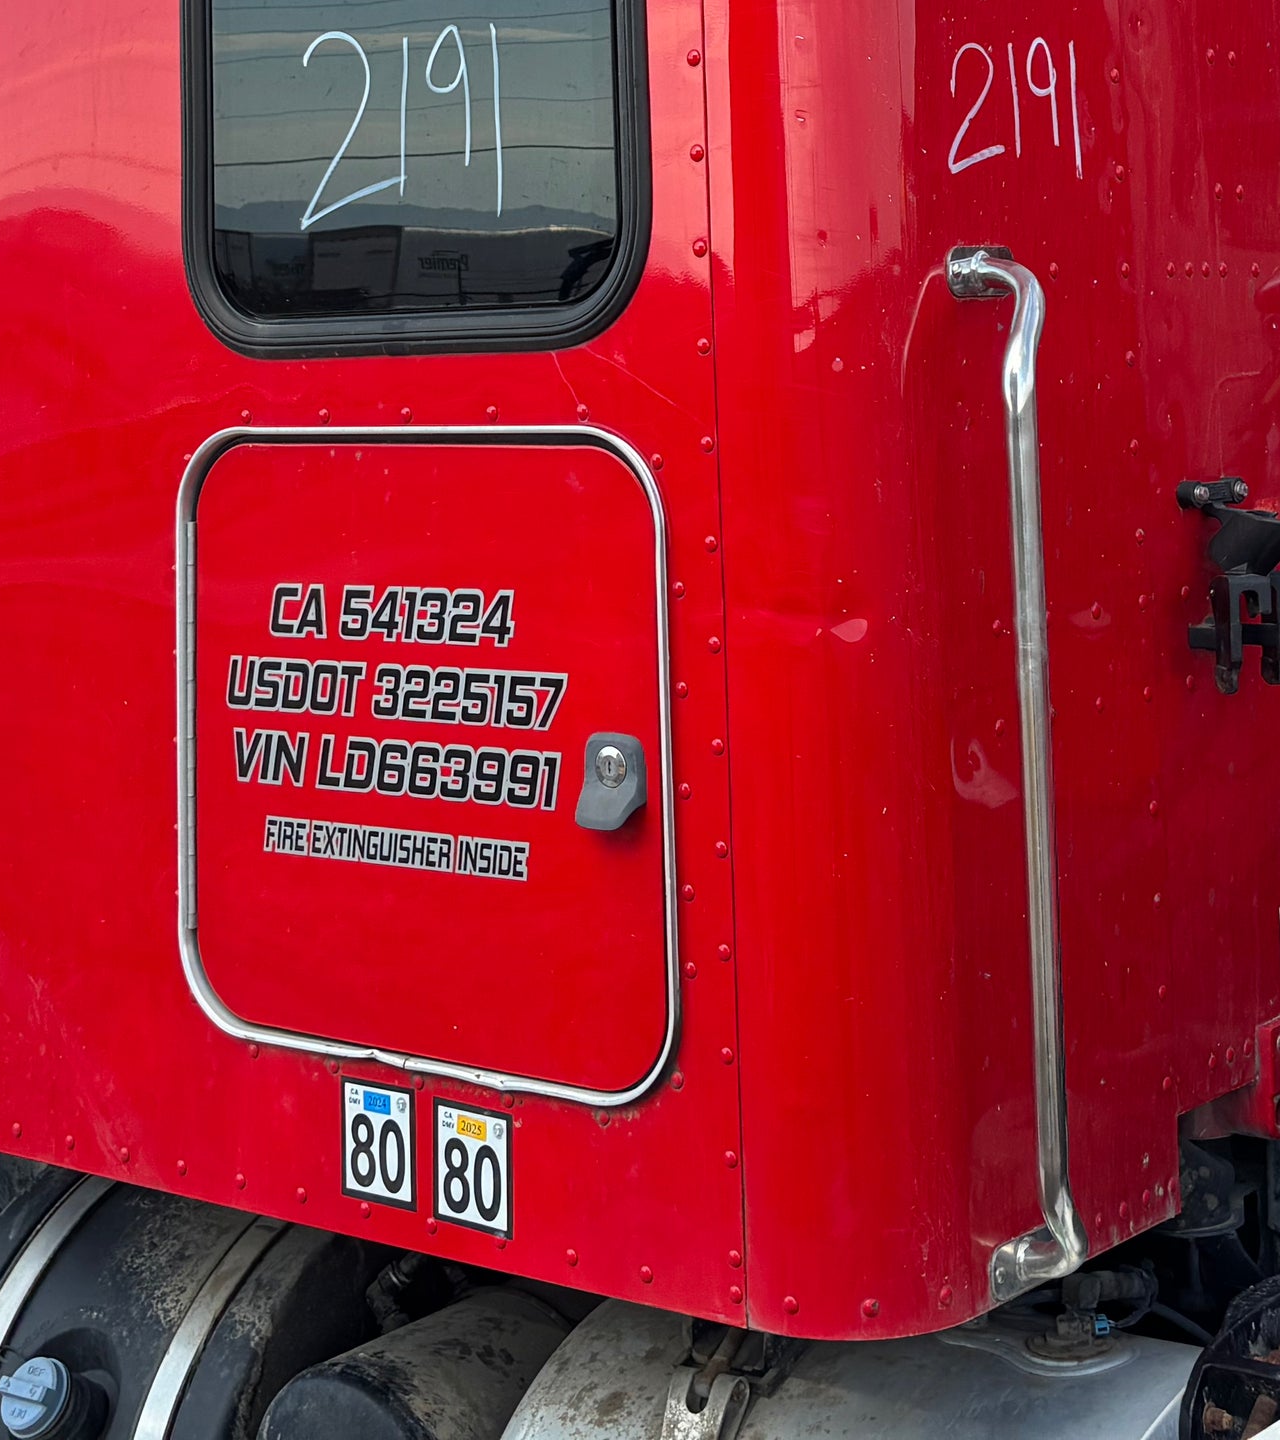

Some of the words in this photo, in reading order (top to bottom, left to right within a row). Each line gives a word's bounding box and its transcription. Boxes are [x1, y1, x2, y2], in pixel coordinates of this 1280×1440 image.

[299, 21, 504, 231] 2191
[948, 36, 1084, 180] 2191
[269, 582, 328, 640] CA
[338, 584, 515, 648] 541324
[225, 654, 368, 718] USDOT
[370, 662, 569, 732] 3225157
[233, 727, 310, 788] VIN
[314, 733, 563, 812] LD663991
[263, 814, 311, 854] FIRE
[308, 819, 455, 874] EXTINGUISHER
[454, 834, 530, 882] INSIDE
[350, 1088, 359, 1096] CA
[368, 1095, 388, 1109] 2024
[443, 1111, 453, 1120] CA
[350, 1113, 406, 1194] 80
[459, 1119, 483, 1137] 2025
[443, 1137, 503, 1222] 80
[27, 1365, 47, 1377] DEF
